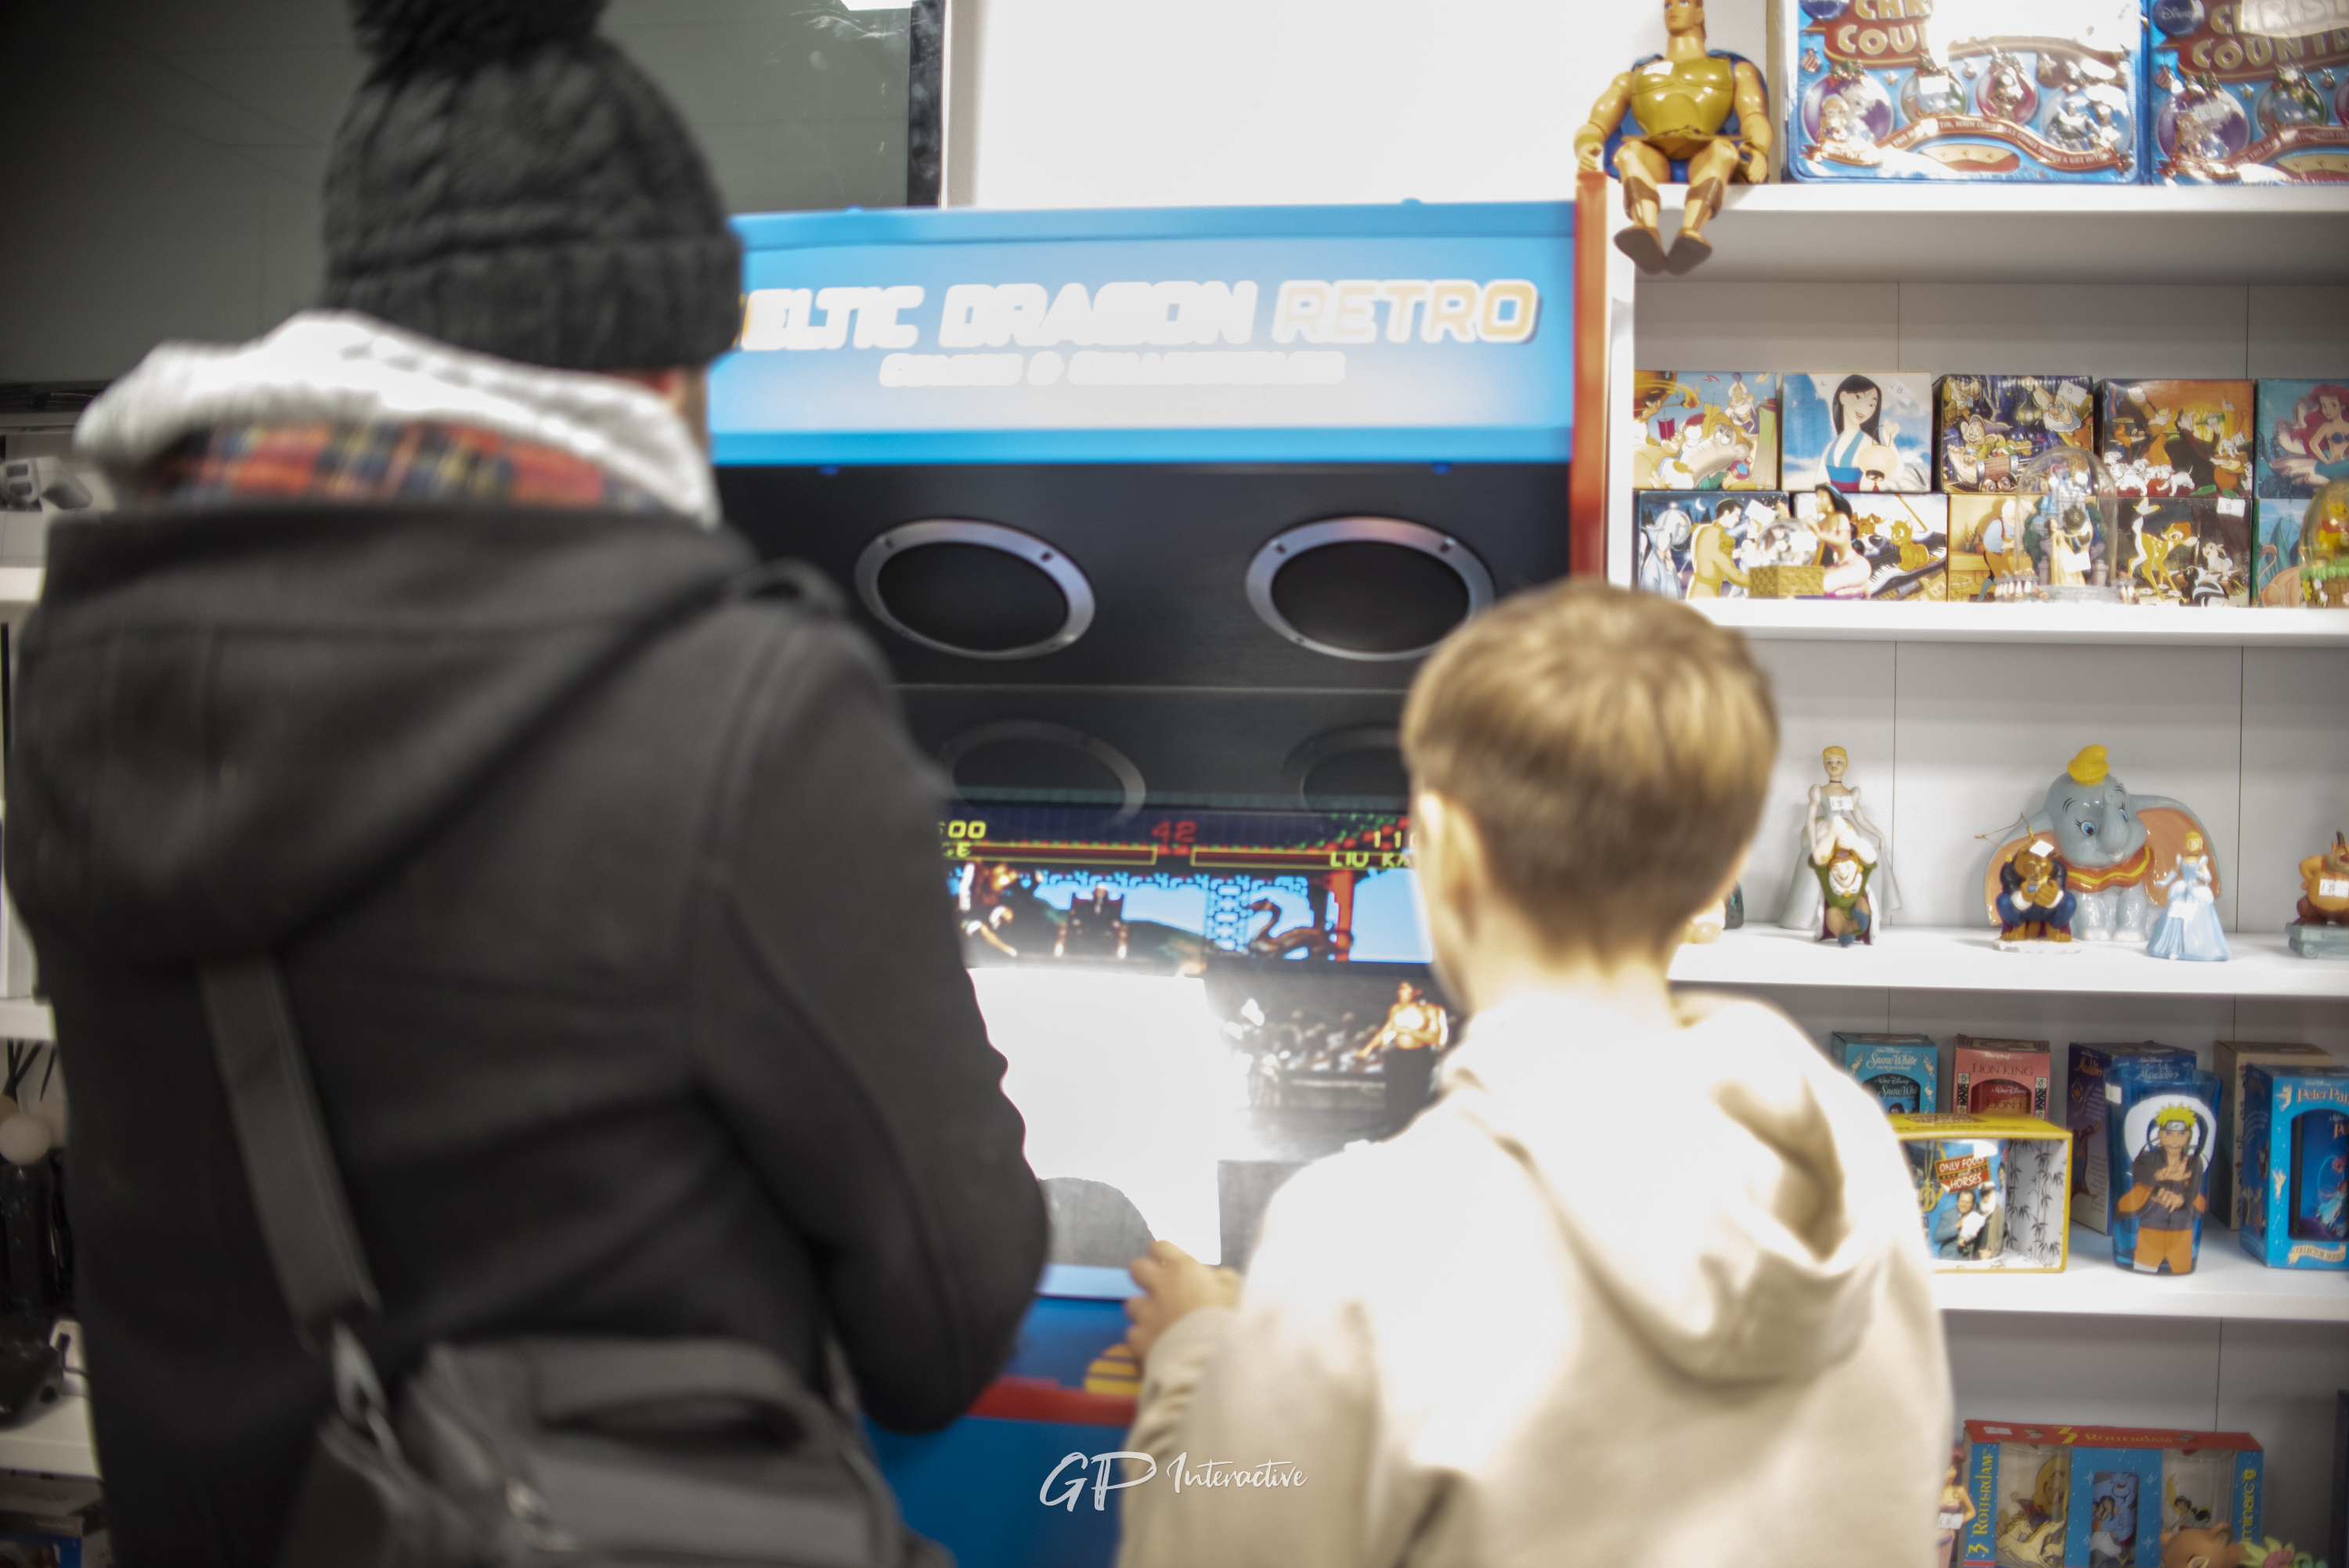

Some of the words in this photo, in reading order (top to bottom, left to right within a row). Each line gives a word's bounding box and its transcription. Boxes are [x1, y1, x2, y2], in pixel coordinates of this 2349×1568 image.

[1271, 279, 1544, 346] RETRO
[1330, 851, 1370, 868] LIU
[1865, 1052, 1893, 1069] Snow
[1892, 1054, 1918, 1066] White
[2074, 1056, 2103, 1078] Aladdin
[1972, 1063, 2001, 1074] LION
[2003, 1065, 2034, 1076] KING
[2296, 1088, 2328, 1105] Peter
[1939, 1160, 1961, 1173] ONLY
[1950, 1172, 1983, 1190] HORSES
[2051, 1426, 2078, 1444] 3
[1968, 1543, 1990, 1554] 3
